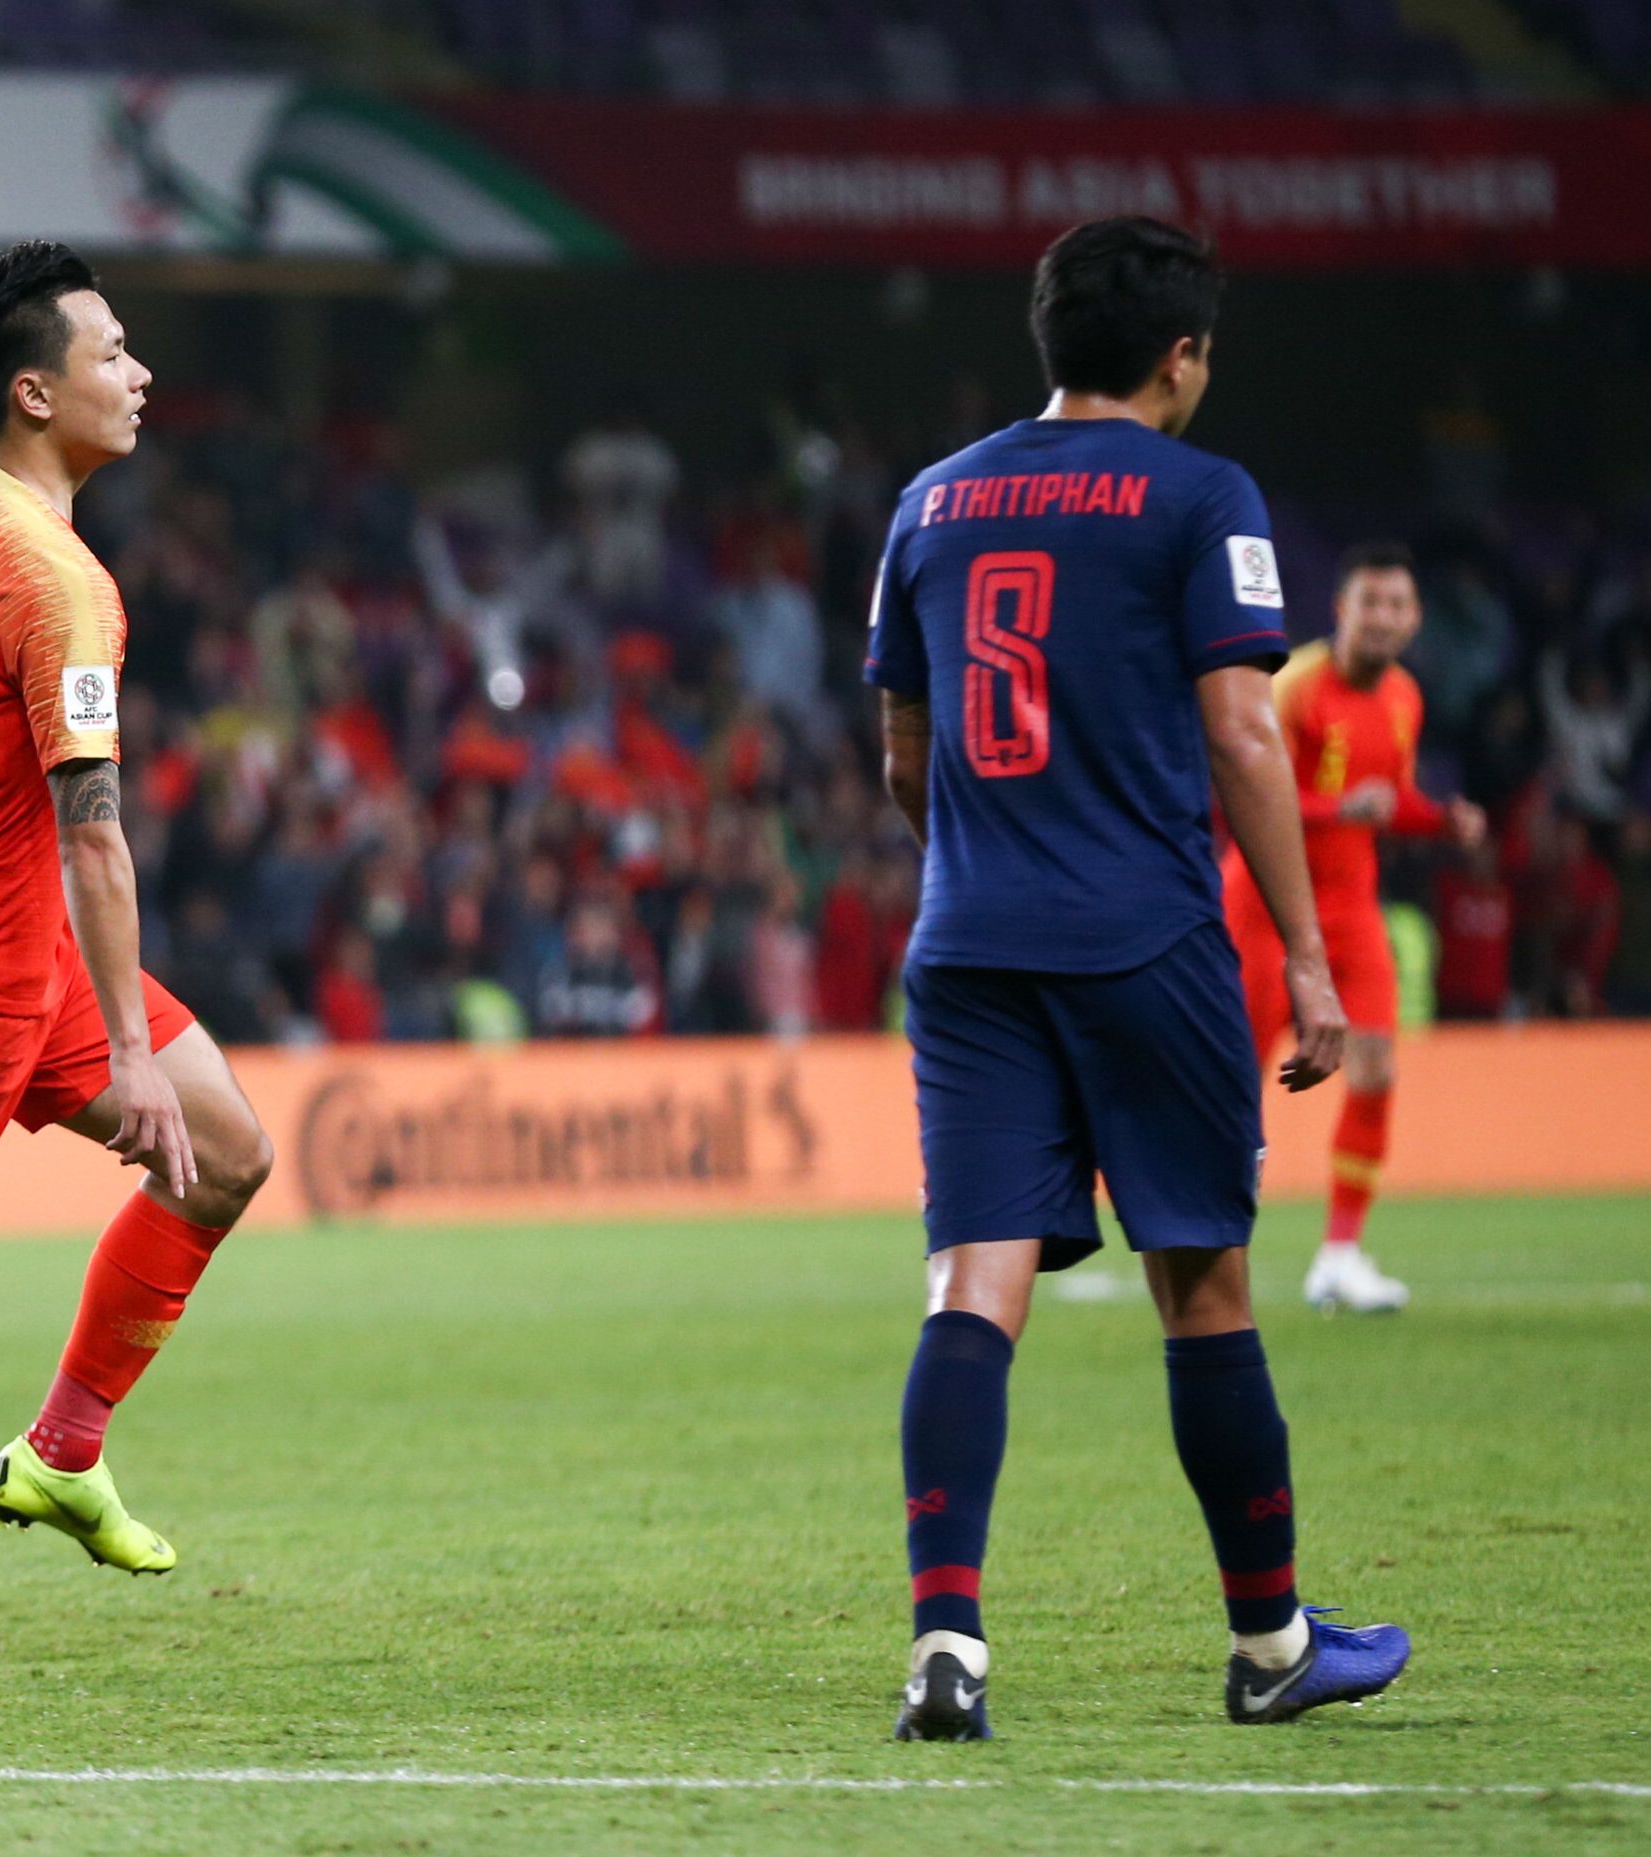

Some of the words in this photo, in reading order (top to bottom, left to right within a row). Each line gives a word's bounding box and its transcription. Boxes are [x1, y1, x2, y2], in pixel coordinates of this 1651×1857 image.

[1017, 155, 1179, 225] ASIA
[1193, 155, 1555, 226] TOGETHER
[919, 473, 1150, 527] P.THITIPHAN
